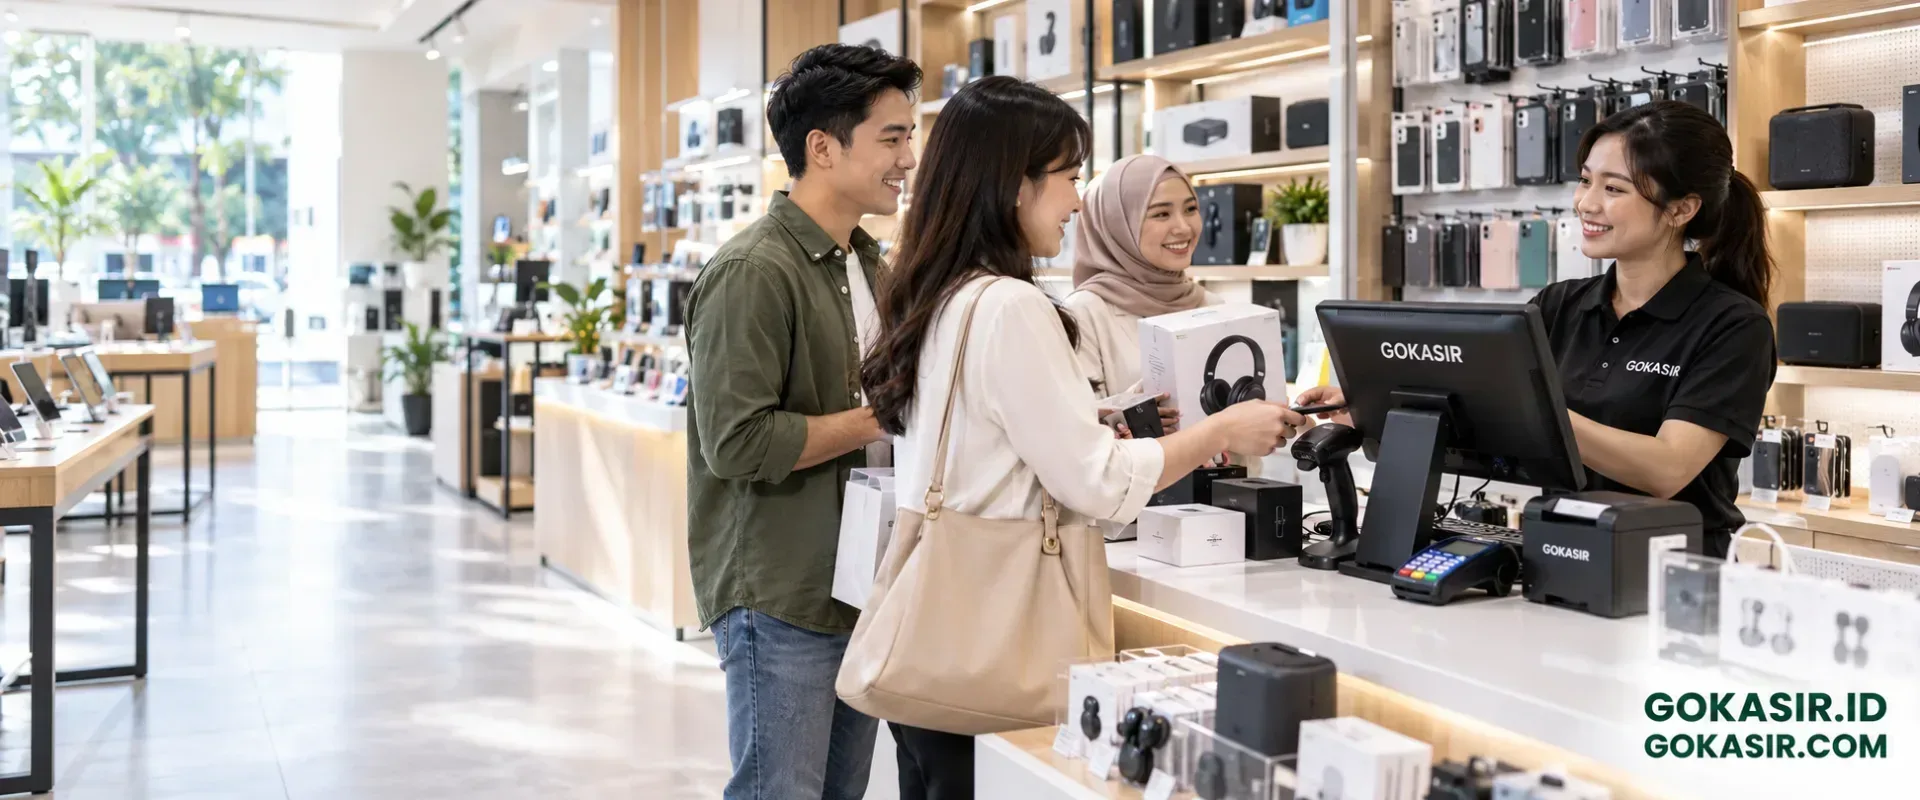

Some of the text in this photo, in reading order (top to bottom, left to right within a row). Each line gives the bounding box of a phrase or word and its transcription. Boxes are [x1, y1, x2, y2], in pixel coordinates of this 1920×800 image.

[1380, 341, 1463, 363] GOKASIR
[1625, 360, 1681, 377] GOKASIR
[1542, 543, 1590, 562] GOKASIR
